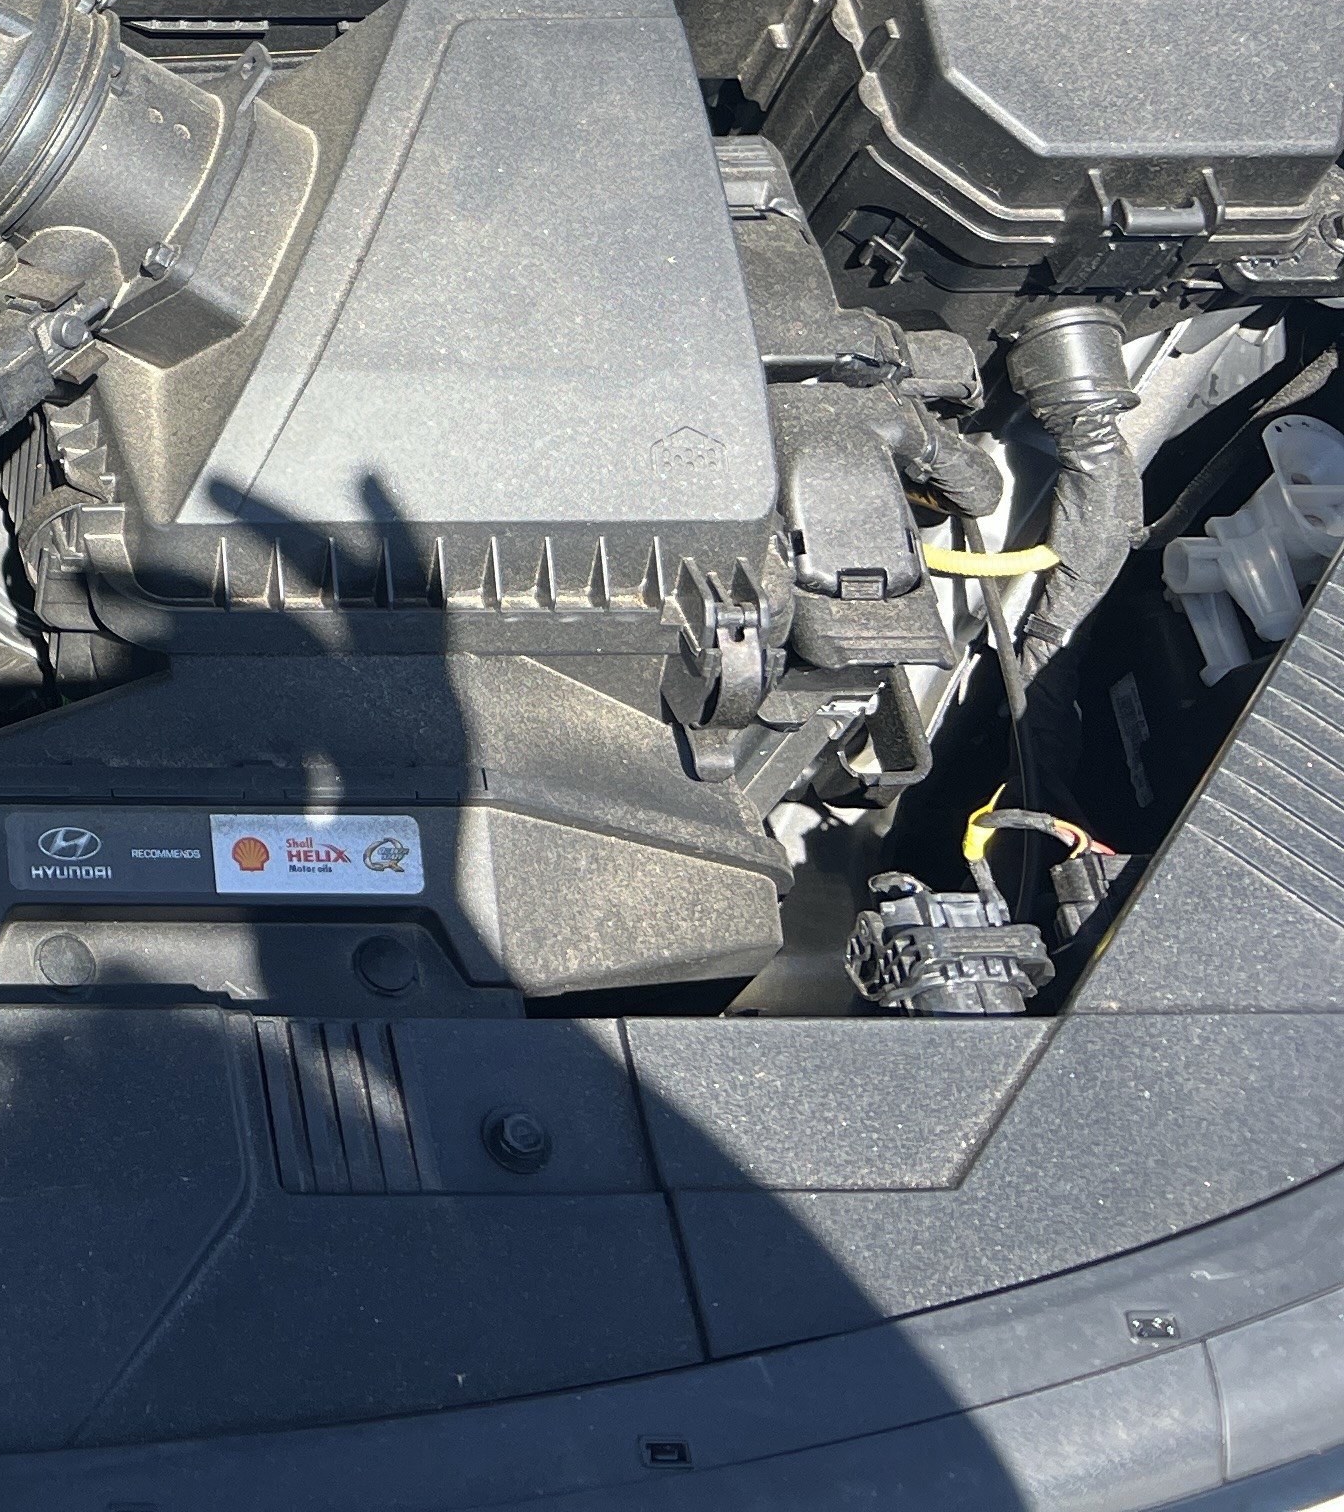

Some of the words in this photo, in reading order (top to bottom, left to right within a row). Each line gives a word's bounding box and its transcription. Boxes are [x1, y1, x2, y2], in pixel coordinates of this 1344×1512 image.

[285, 837, 314, 848] Shell
[286, 848, 349, 863] HELIX
[31, 865, 112, 879] HYUNDAI
[130, 848, 201, 859] RECOMMENDS
[288, 864, 316, 873] Motor
[317, 864, 333, 873] oils
